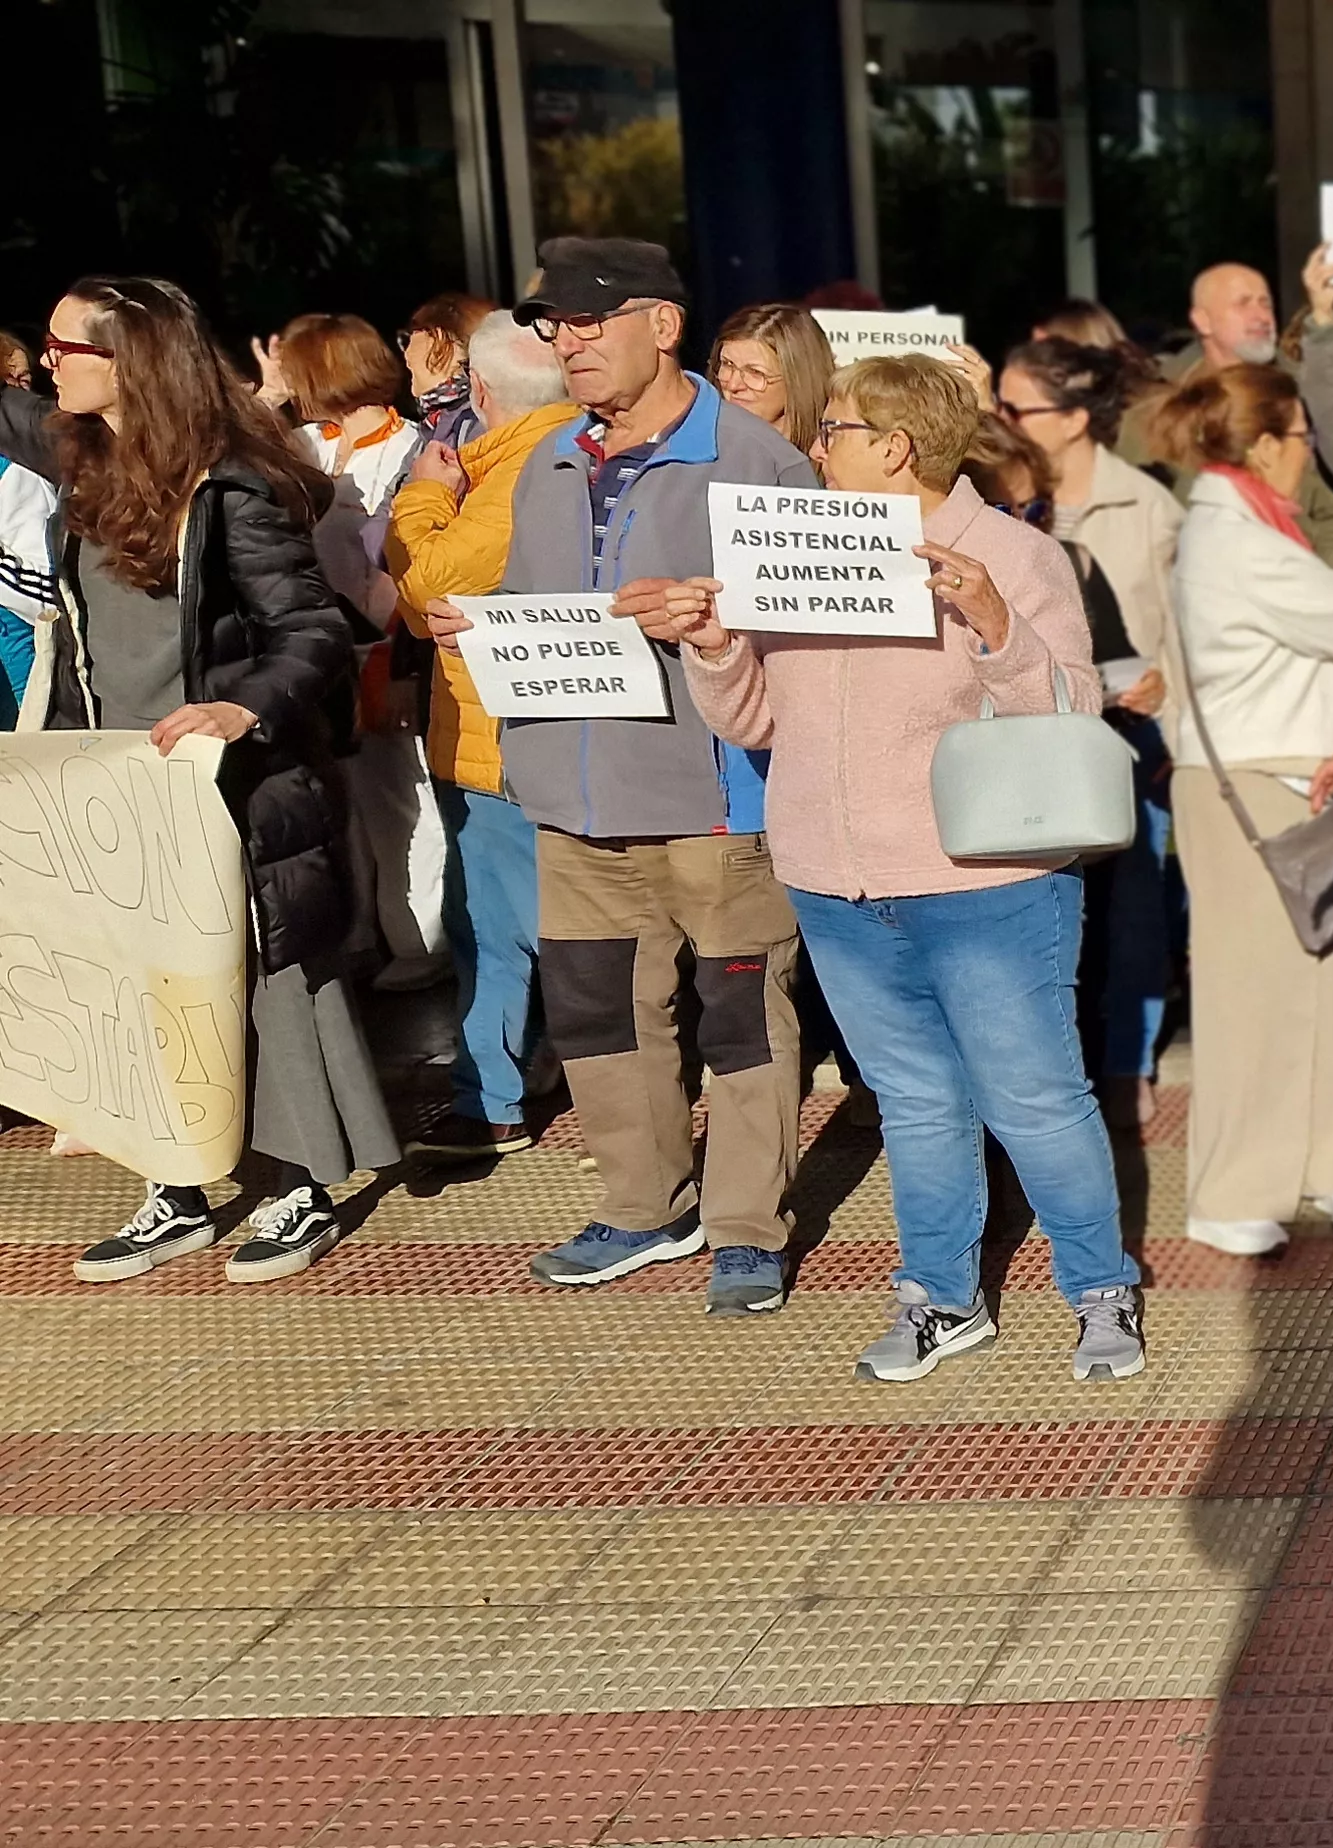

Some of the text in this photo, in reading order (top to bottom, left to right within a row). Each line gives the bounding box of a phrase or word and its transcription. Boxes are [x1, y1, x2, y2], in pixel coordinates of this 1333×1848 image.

[857, 331, 960, 346] PERSONAL
[736, 495, 888, 519] LA PRESIÓN
[731, 528, 902, 552] ASISTENCIAL
[755, 564, 886, 582] AUMENTA
[754, 596, 895, 614] SIN PARAR
[485, 608, 602, 625] MI SALUD
[491, 641, 624, 663] NO PUEDE
[510, 677, 627, 698] ESPERAR
